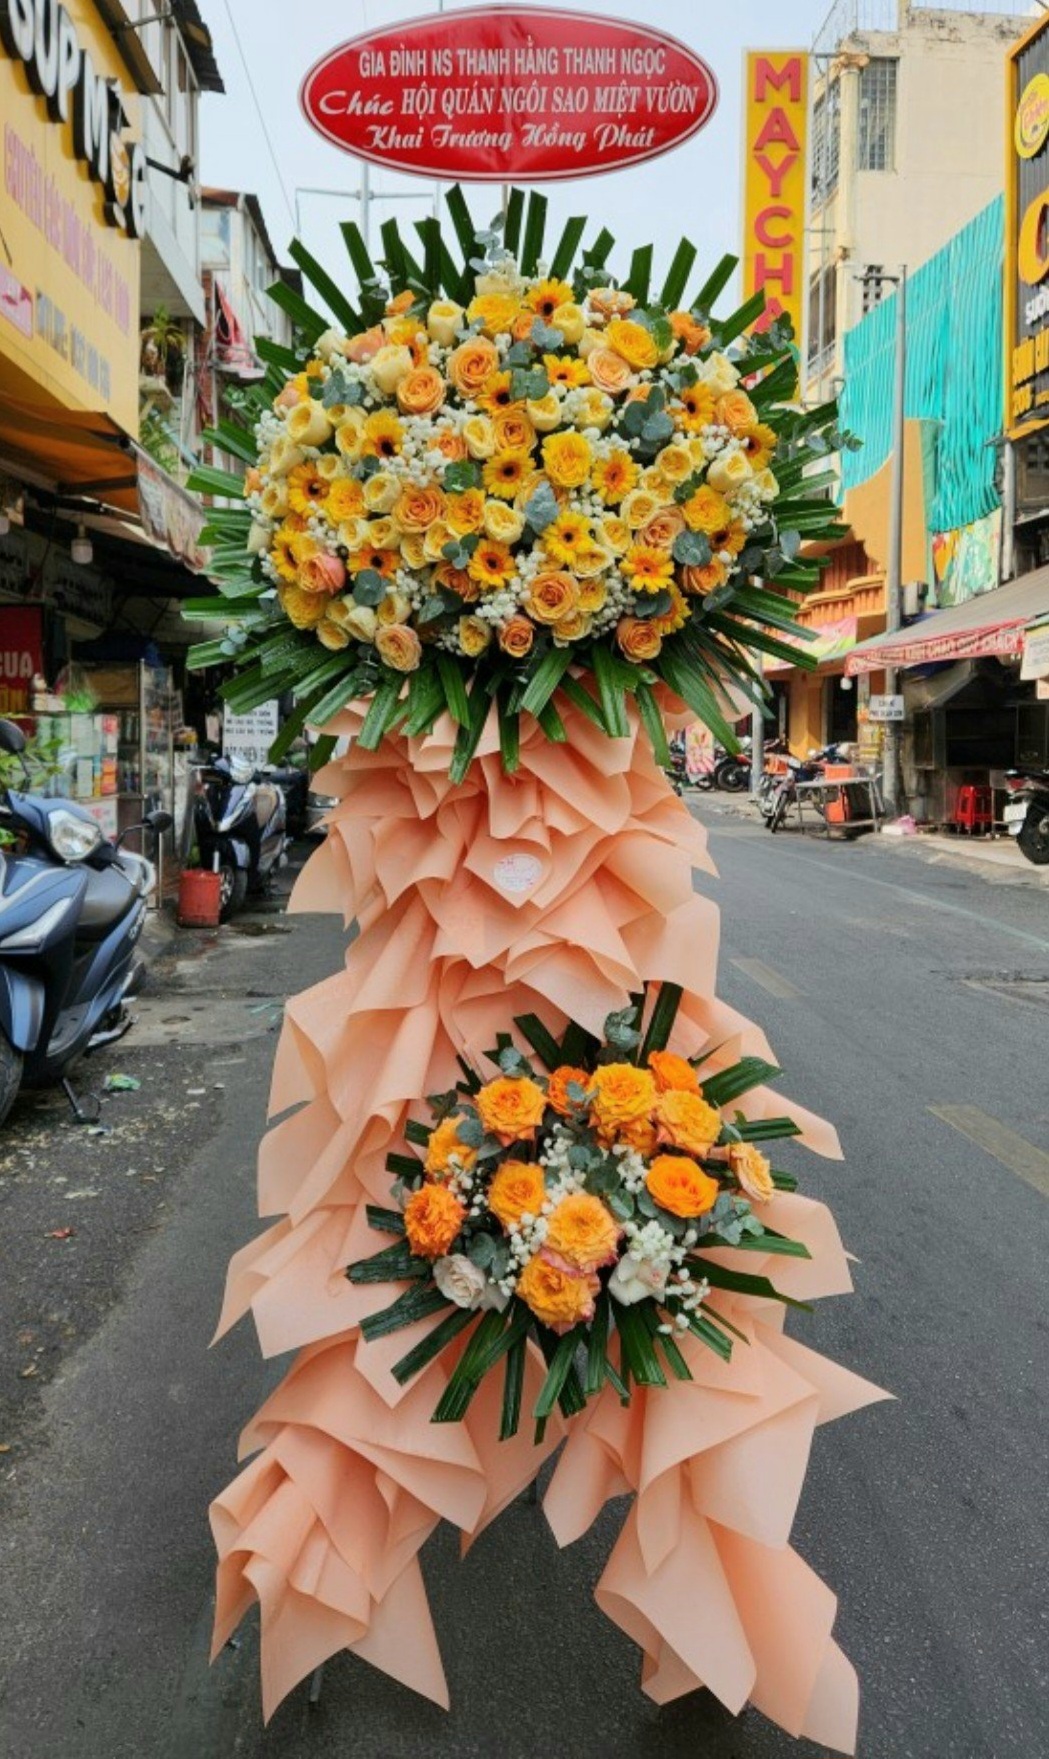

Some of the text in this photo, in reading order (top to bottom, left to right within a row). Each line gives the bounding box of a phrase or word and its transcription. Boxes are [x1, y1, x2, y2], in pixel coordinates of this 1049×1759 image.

[359, 51, 386, 78] GIA
[390, 42, 427, 77] ĐÌNH
[431, 49, 453, 76] NS
[457, 48, 510, 76] THANH
[563, 47, 616, 75] THANH
[621, 47, 666, 80] NGỌC
[318, 79, 699, 120] Chúc HỘI QUÁN NGÔI SAO MIỆT VƯỜN
[362, 121, 657, 152] Khai Trương Hồng Phát
[0, 651, 34, 678] UA
